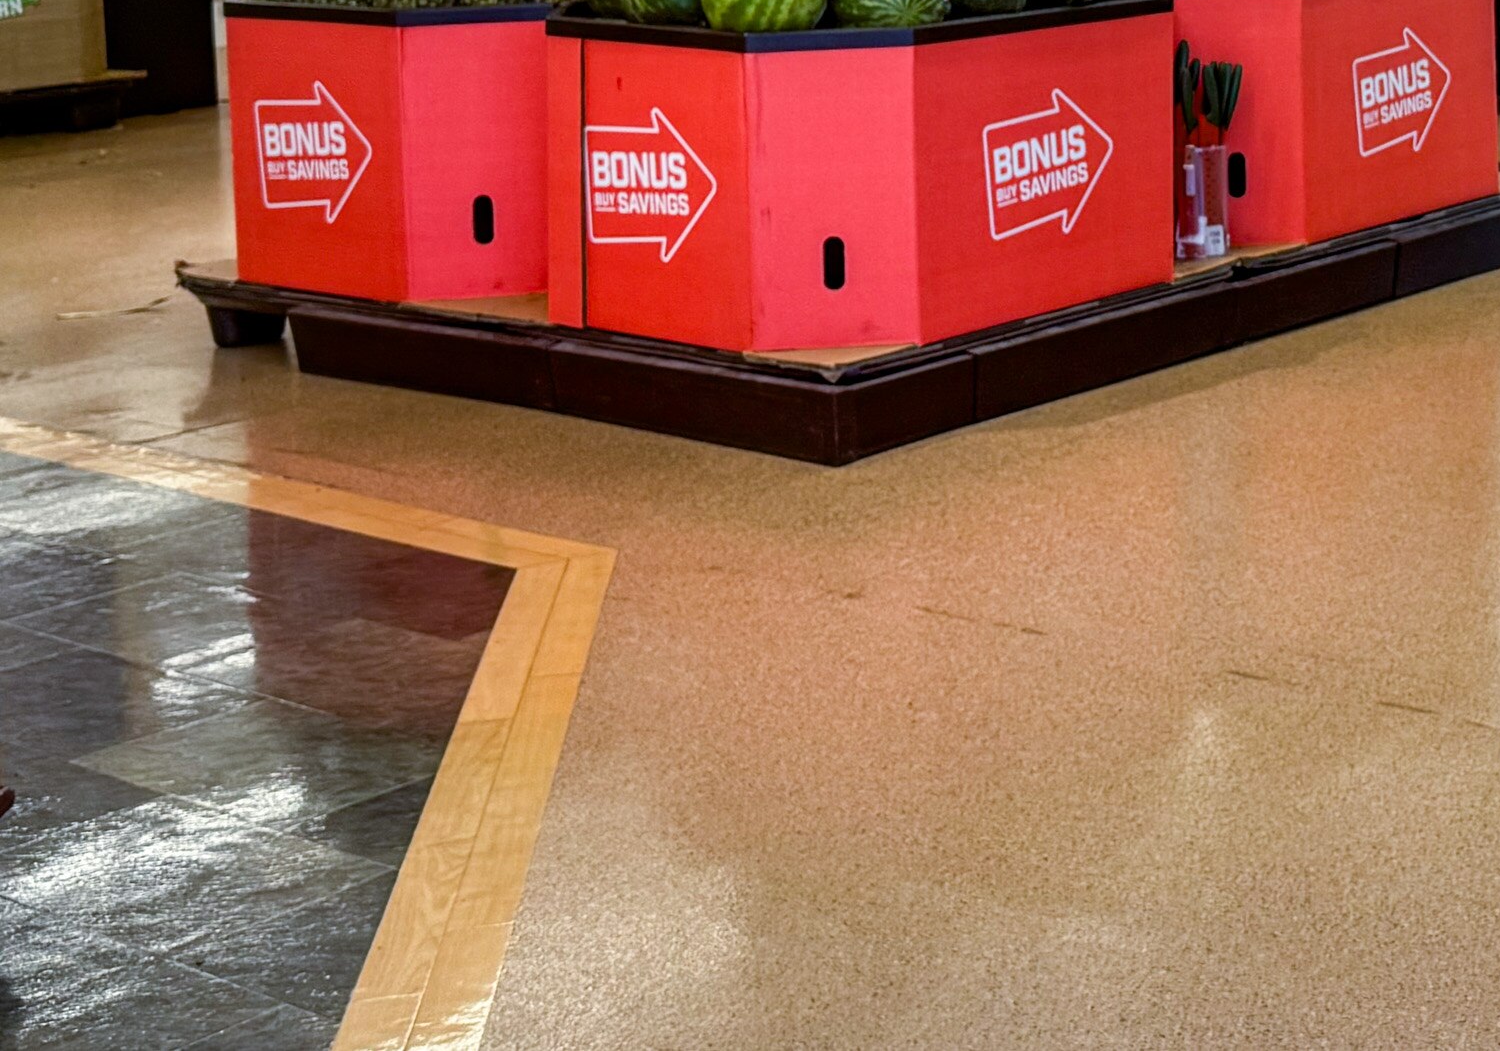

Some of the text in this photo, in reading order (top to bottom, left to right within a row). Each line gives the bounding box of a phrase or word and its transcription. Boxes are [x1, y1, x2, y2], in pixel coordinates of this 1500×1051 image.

[1361, 58, 1430, 109] BONUS
[1380, 90, 1432, 124] SAVINGS
[264, 121, 347, 157] BONUS
[993, 124, 1086, 184] BONUS
[287, 159, 349, 181] SAVINGS
[592, 151, 687, 189] BONUS
[996, 161, 1089, 202] BUY SAVINGS
[594, 192, 690, 216] BUY SAVINGS
